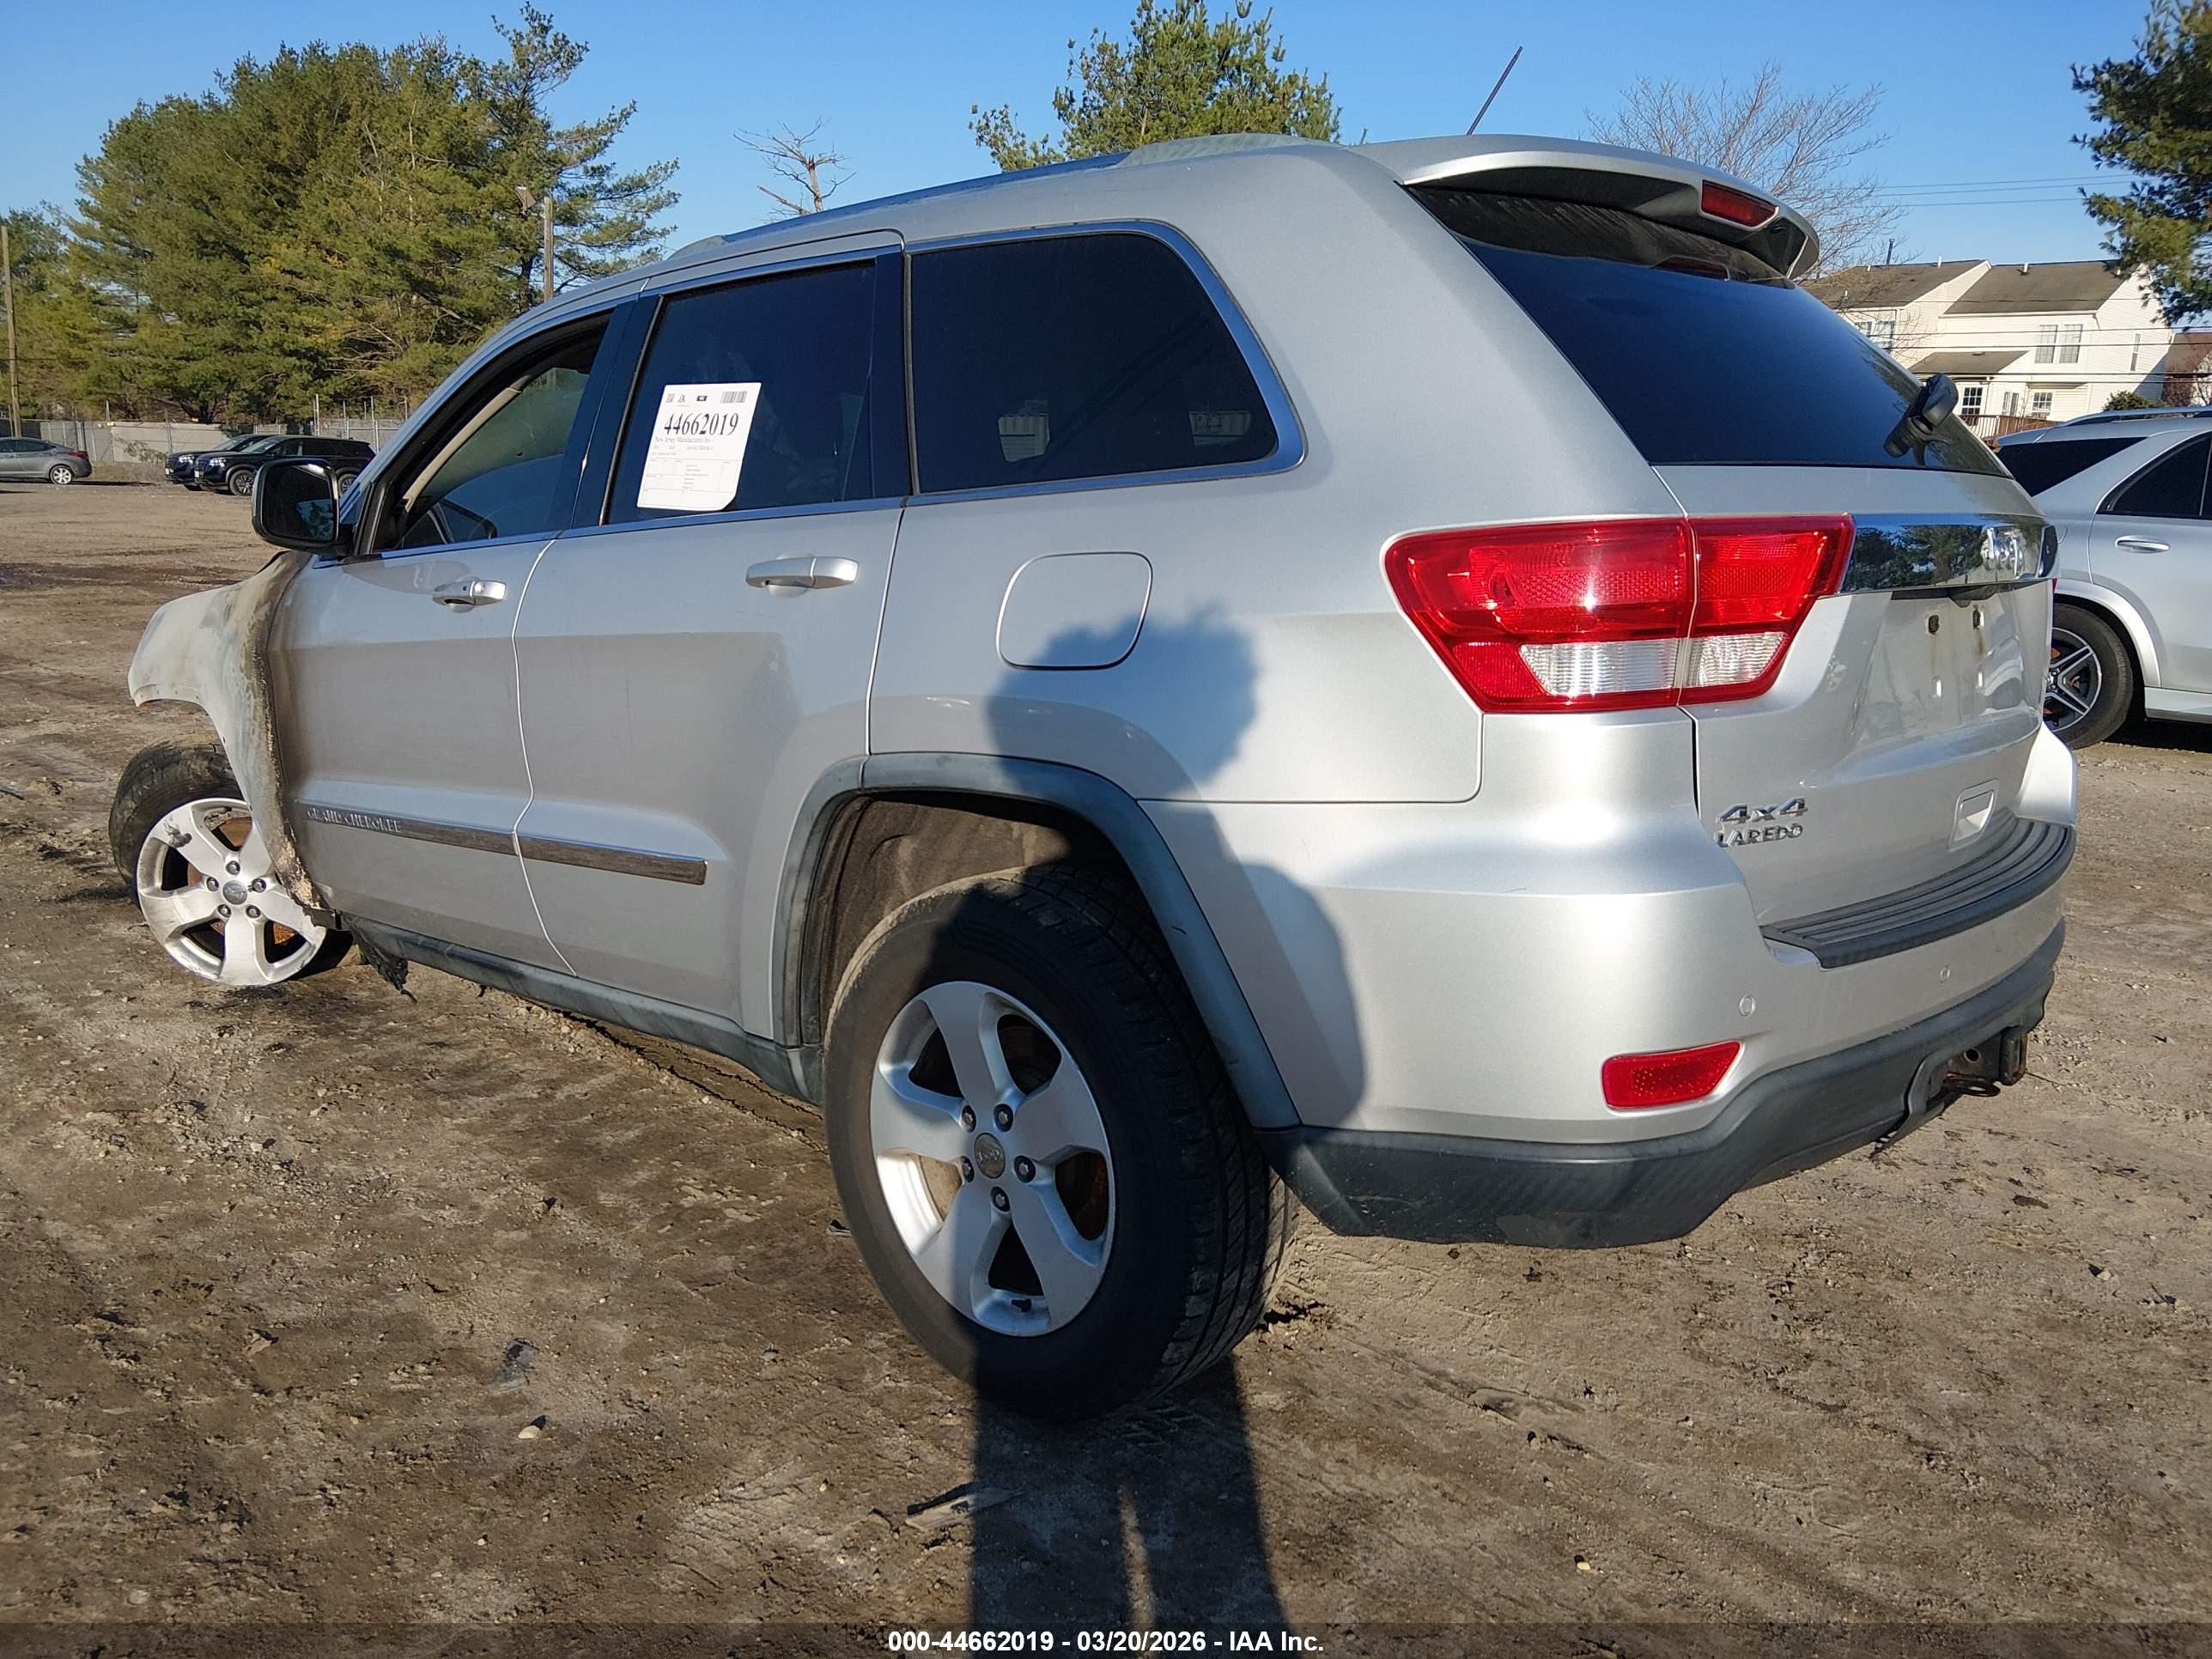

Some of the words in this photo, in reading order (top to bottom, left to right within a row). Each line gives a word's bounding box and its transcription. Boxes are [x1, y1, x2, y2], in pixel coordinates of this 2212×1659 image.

[664, 412, 739, 436] 44662019
[1716, 797, 1808, 825] 4x4
[1714, 823, 1803, 850] LAREDO
